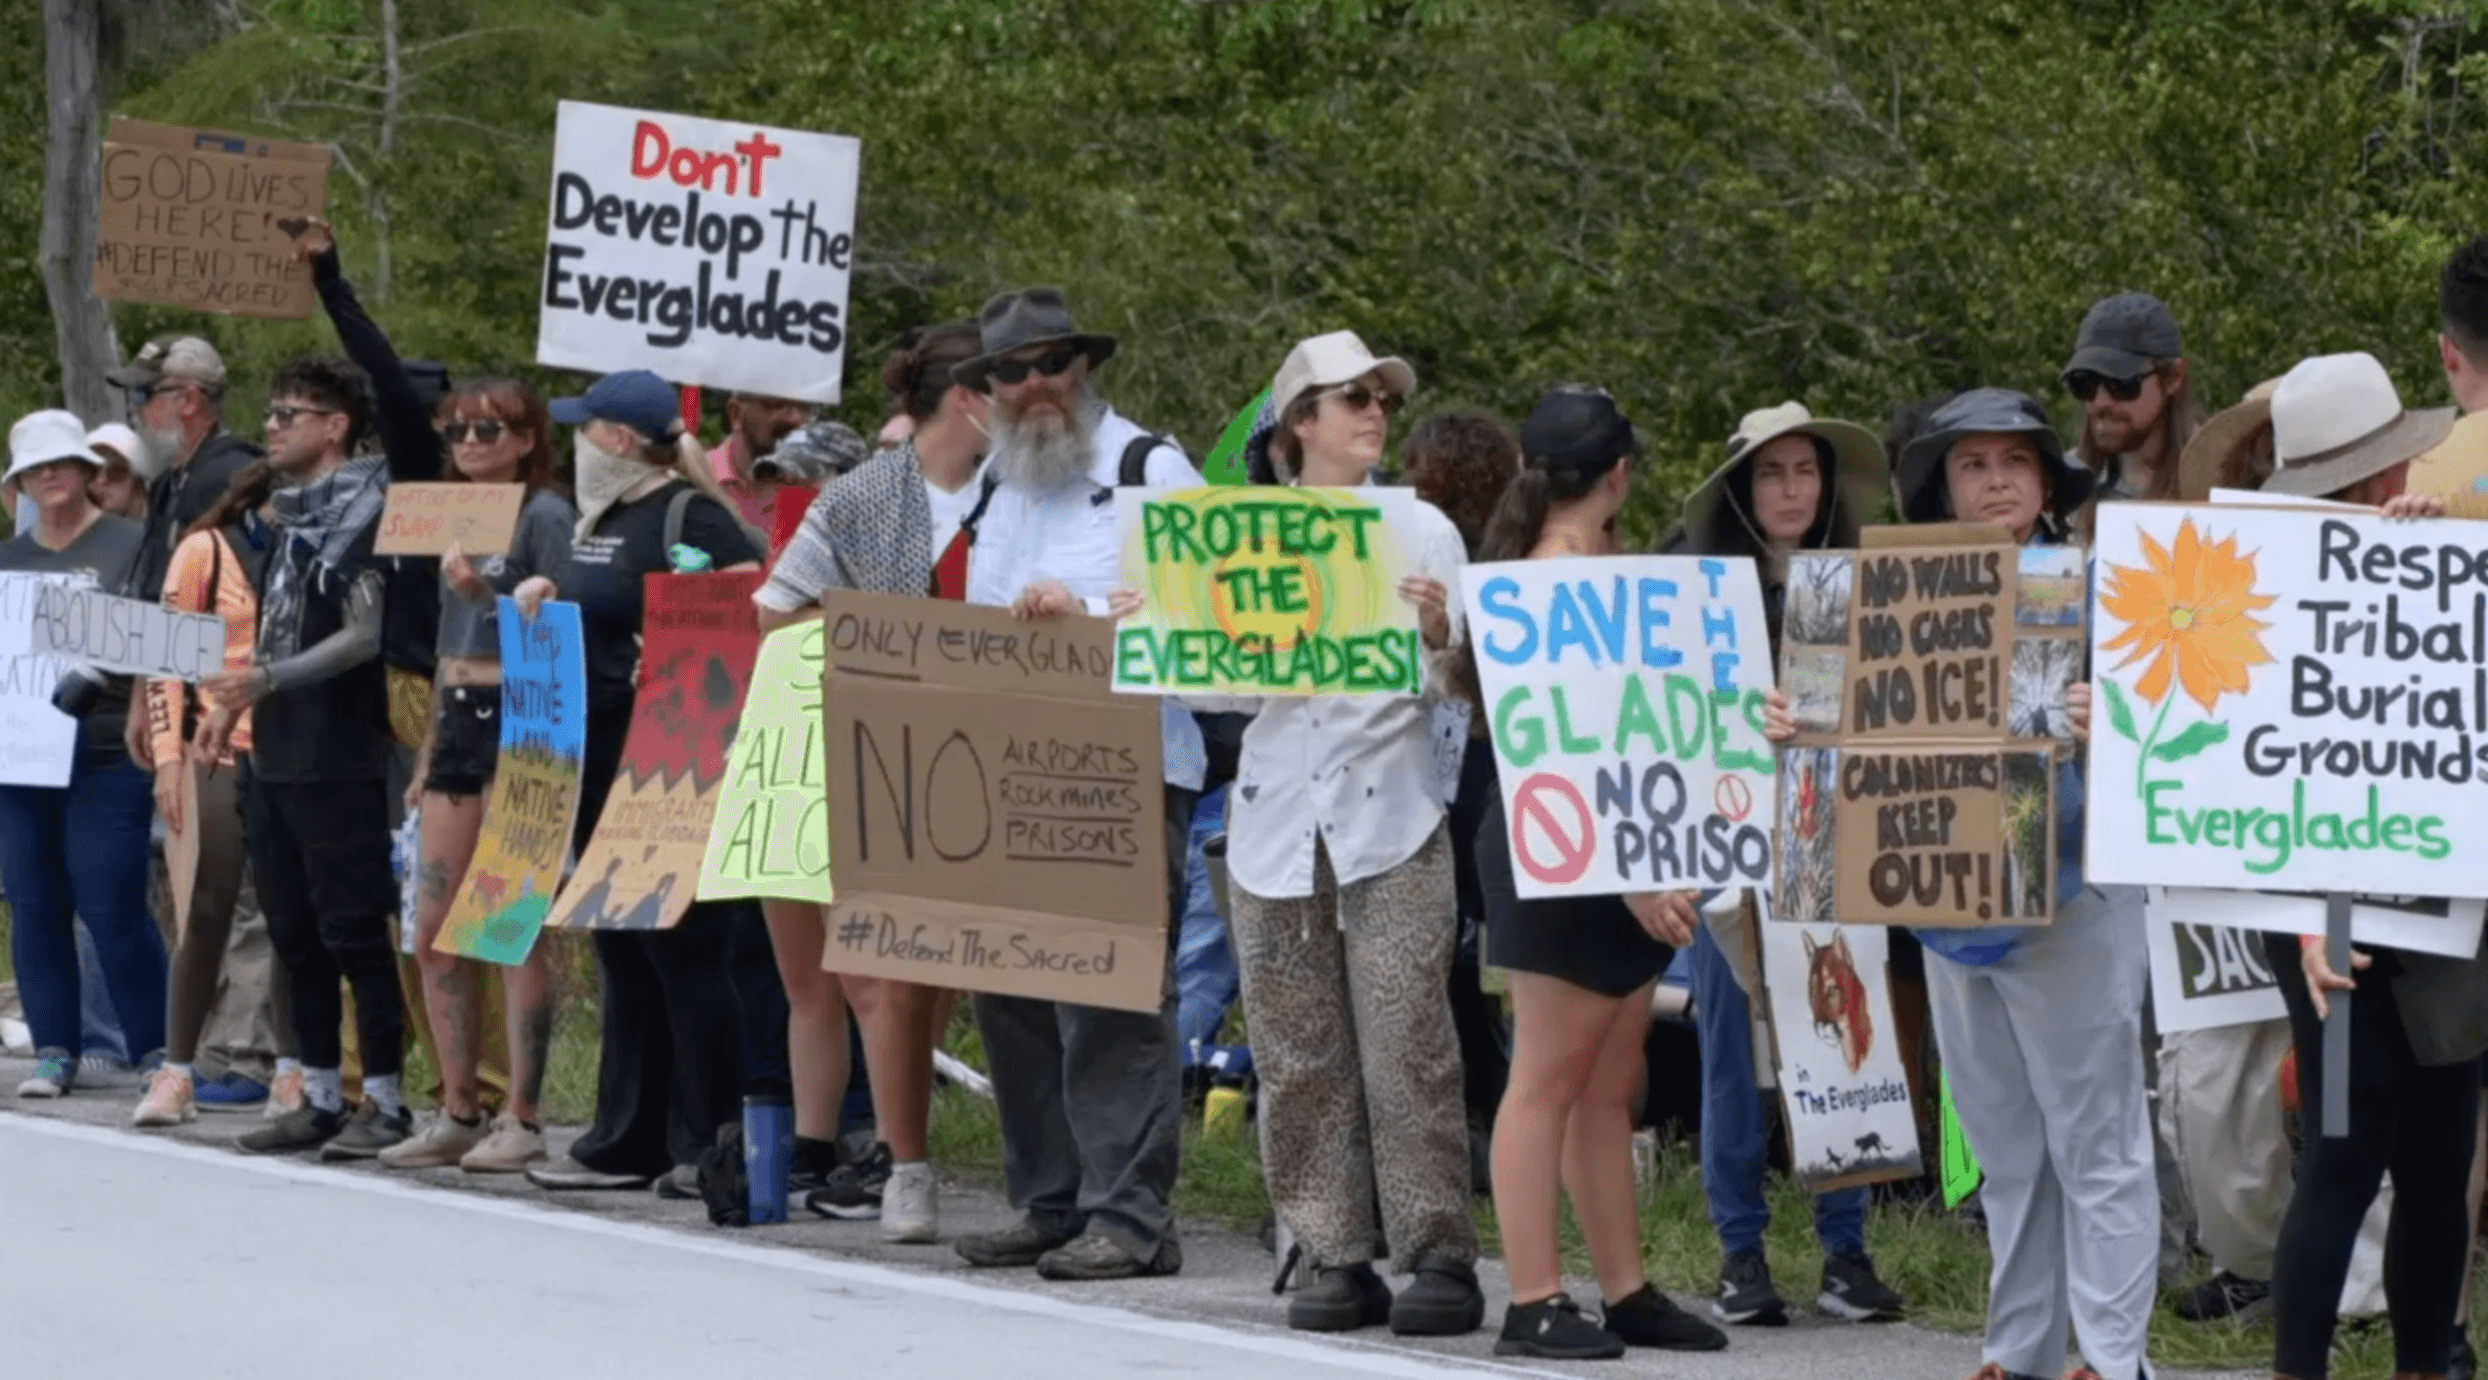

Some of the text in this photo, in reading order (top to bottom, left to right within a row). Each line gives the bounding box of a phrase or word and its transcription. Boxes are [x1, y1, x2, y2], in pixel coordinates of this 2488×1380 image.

[104, 149, 215, 203] GOD
[134, 202, 273, 242] HERE!
[554, 171, 851, 280] Develop the
[245, 251, 301, 282] THE
[545, 243, 842, 354] Everglades
[1143, 501, 1382, 564] PROTECT
[1215, 564, 1310, 614] THE
[1860, 551, 2002, 609] NO WALLS
[33, 584, 221, 680] ABOLISH ICE
[831, 612, 1113, 677] ONLY EVERGLAD
[1478, 574, 1686, 668] SAVE
[1858, 602, 1995, 662] NO CAGES
[2297, 591, 2486, 665] Tribal
[1117, 626, 1421, 697] EVERGLADES!
[1854, 655, 2000, 734] NO ICE!
[2291, 655, 2486, 733] Burial
[1494, 672, 1777, 775] GLADES
[853, 719, 1139, 863] NO AIRPORTS
[1596, 761, 1687, 826] NO
[1843, 754, 1999, 802] COLONIZERS
[1006, 820, 1139, 855] PRISONS
[1613, 814, 1774, 885] PRISO
[1877, 796, 1957, 851] KEEP
[2146, 778, 2452, 875] Everglades
[1870, 852, 1992, 921] OUT!
[2184, 923, 2278, 993] SAC
[1828, 1077, 1906, 1114] Everglades
